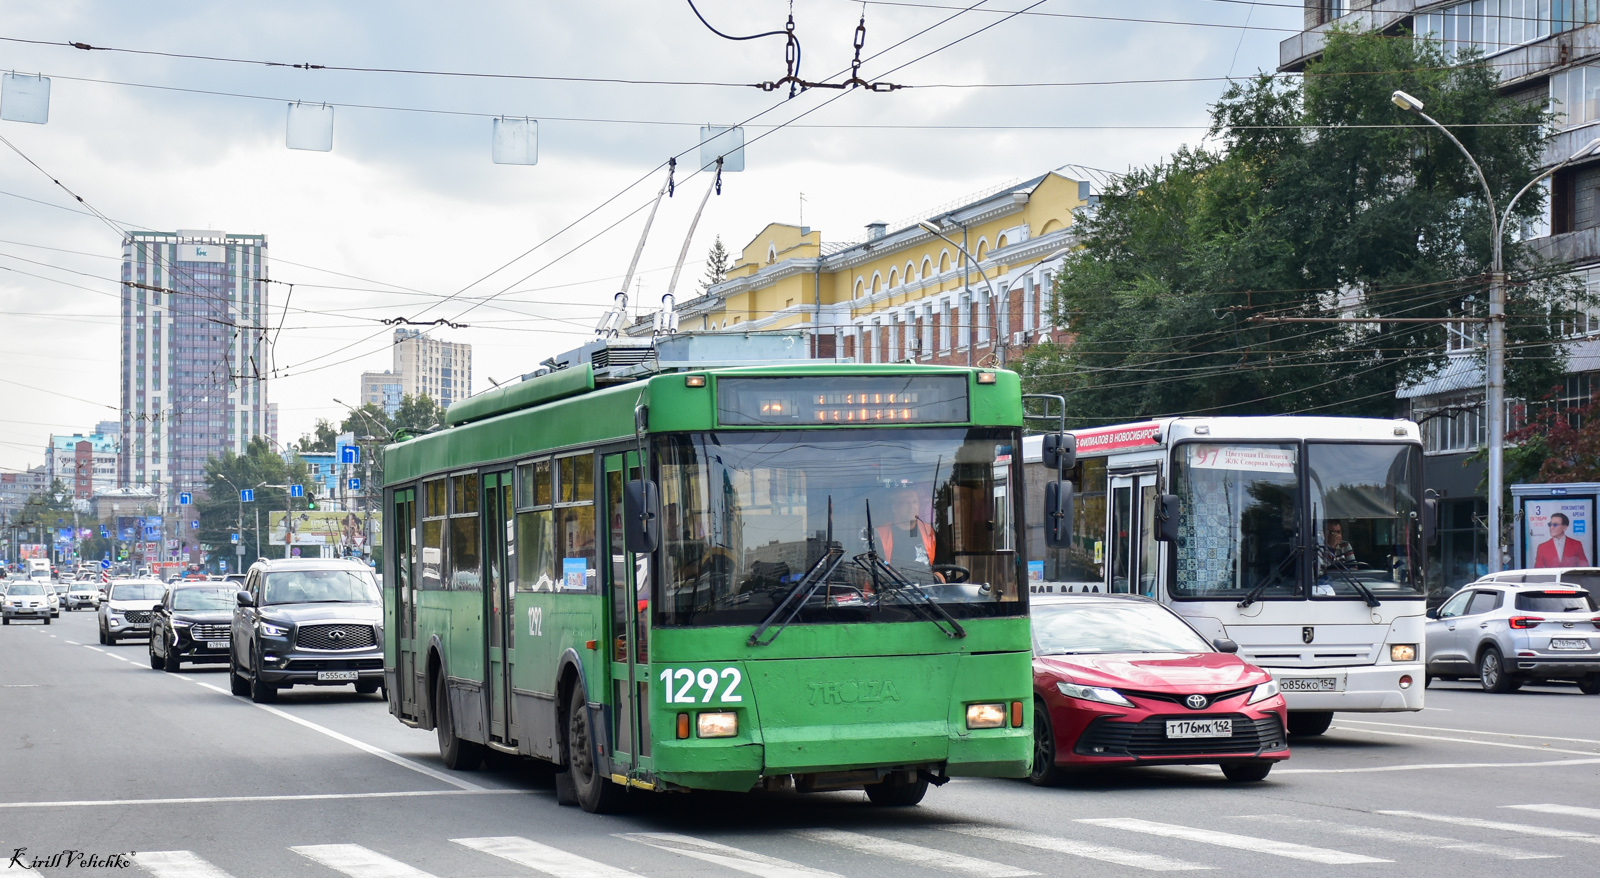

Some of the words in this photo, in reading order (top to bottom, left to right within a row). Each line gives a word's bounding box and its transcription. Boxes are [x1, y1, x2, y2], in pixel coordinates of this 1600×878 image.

[1079, 434, 1109, 448] ФИЛИАЛОВ
[1109, 432, 1114, 444] В
[1196, 447, 1220, 466] 97
[1535, 505, 1541, 516] 3
[528, 606, 542, 636] 1292
[660, 667, 742, 704] 1292
[806, 680, 900, 706] TROLZA
[1282, 679, 1318, 691] О856КО
[1170, 721, 1211, 734] Т176МХ
